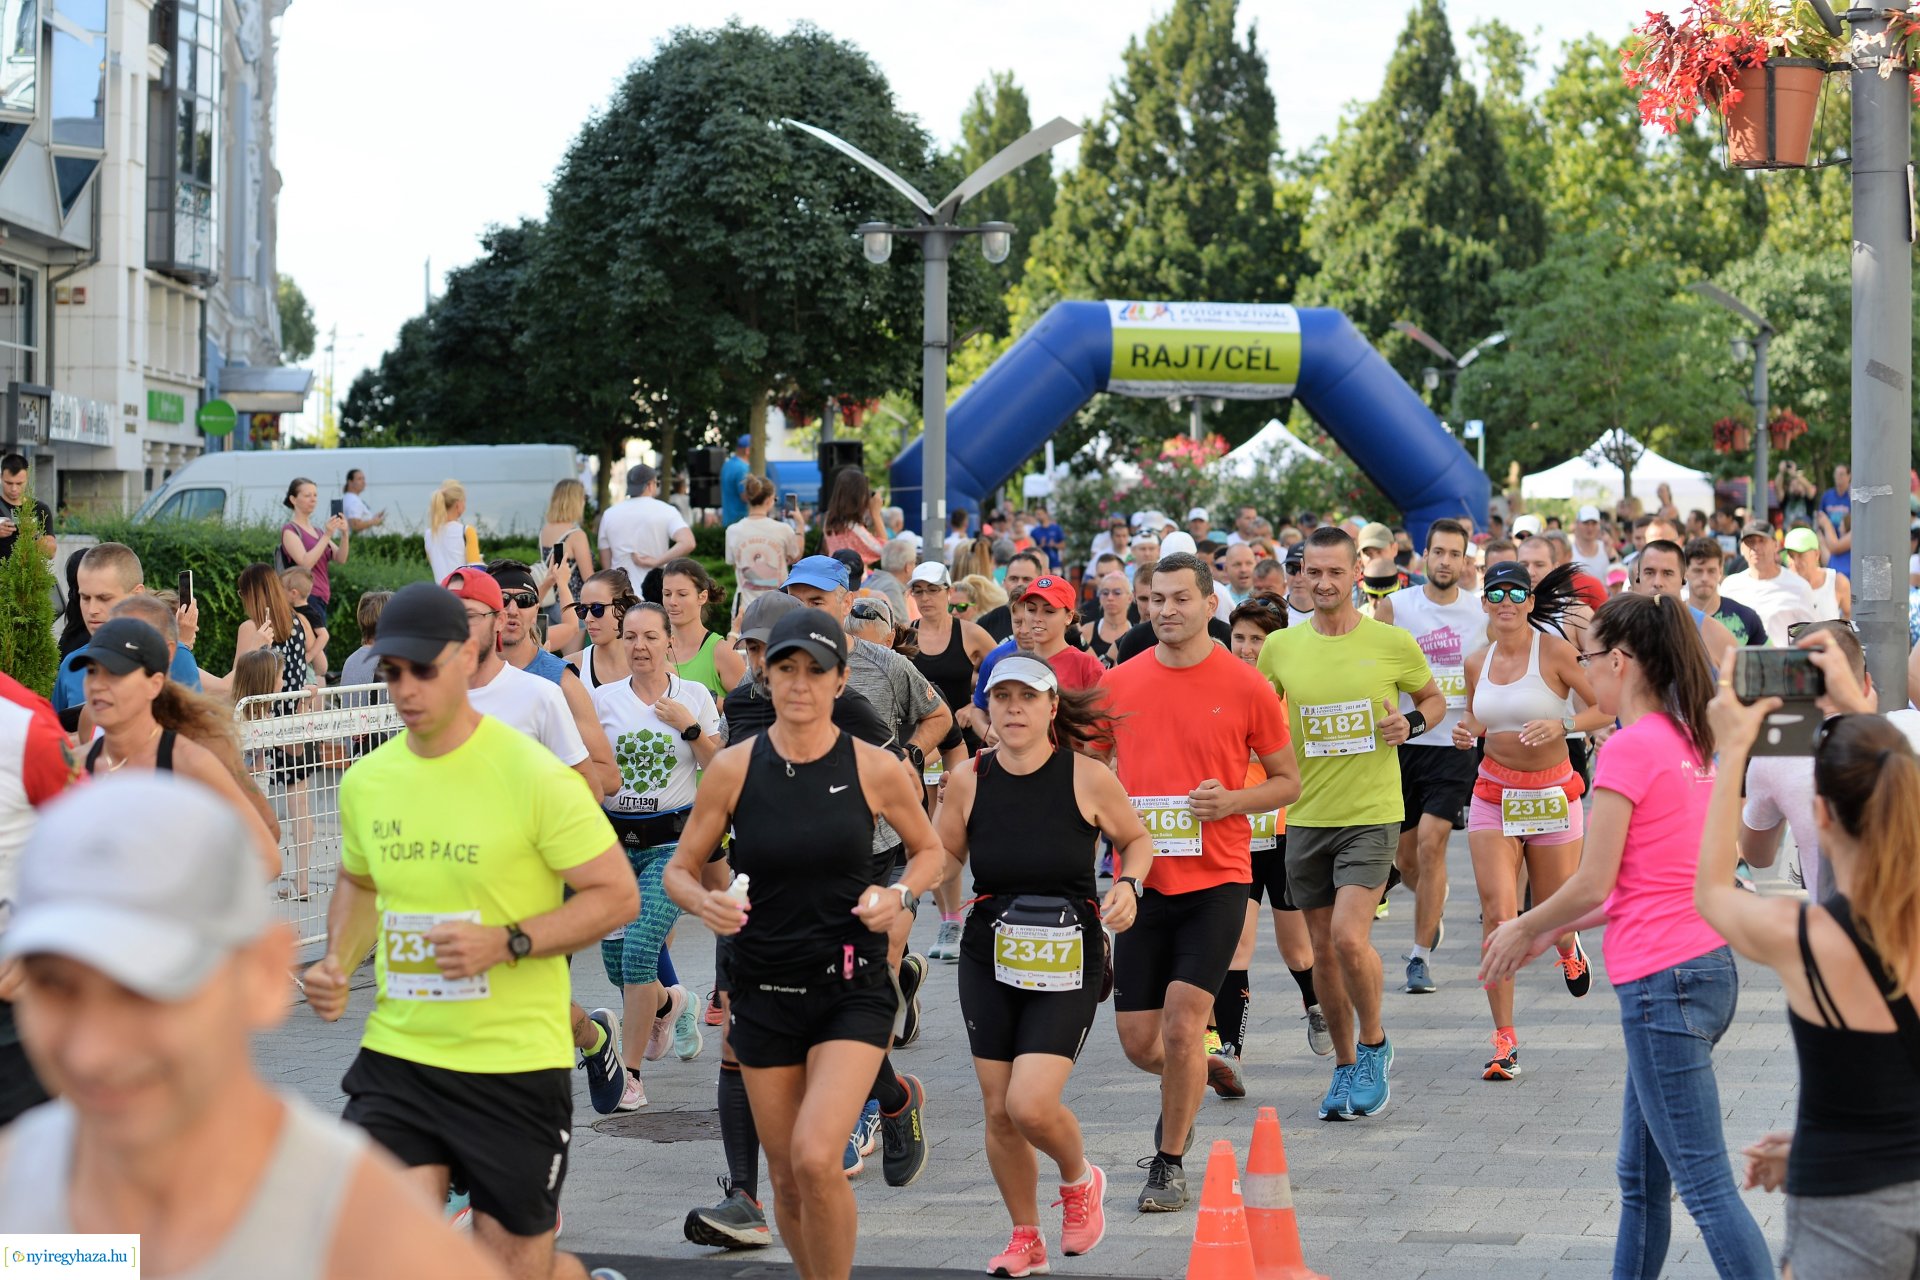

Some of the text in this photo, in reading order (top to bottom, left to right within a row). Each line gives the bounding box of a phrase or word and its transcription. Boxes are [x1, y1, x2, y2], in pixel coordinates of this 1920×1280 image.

[1131, 339, 1280, 372] RAJT/CÉL
[1308, 713, 1366, 735] 2182
[1509, 798, 1562, 816] 2313
[372, 820, 402, 839] RUN
[380, 840, 480, 864] YOUR PACE
[1002, 938, 1074, 964] 2347
